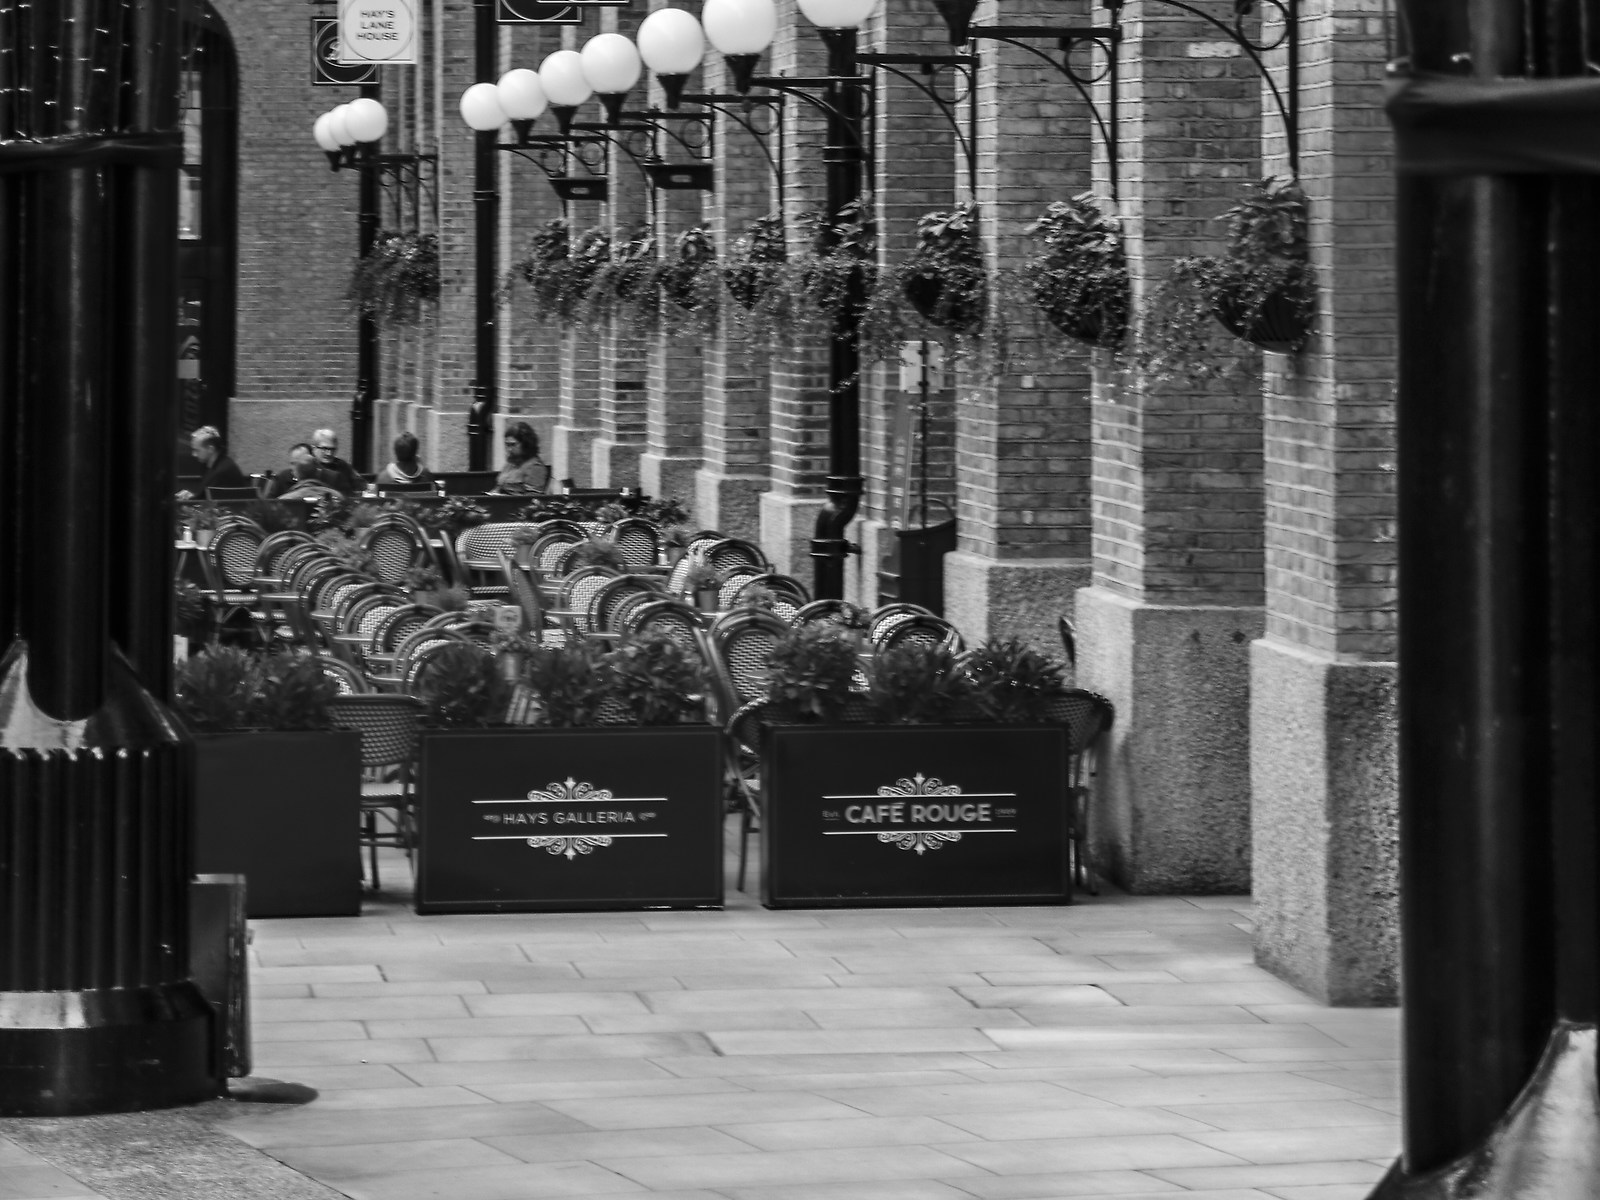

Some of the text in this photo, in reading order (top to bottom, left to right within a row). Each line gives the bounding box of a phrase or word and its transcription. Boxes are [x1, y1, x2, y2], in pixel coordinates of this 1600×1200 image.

[361, 21, 395, 30] LANE
[357, 32, 399, 41] HOUSE
[503, 811, 636, 825] HAYS GALLERIA
[911, 803, 992, 823] ROUGE
